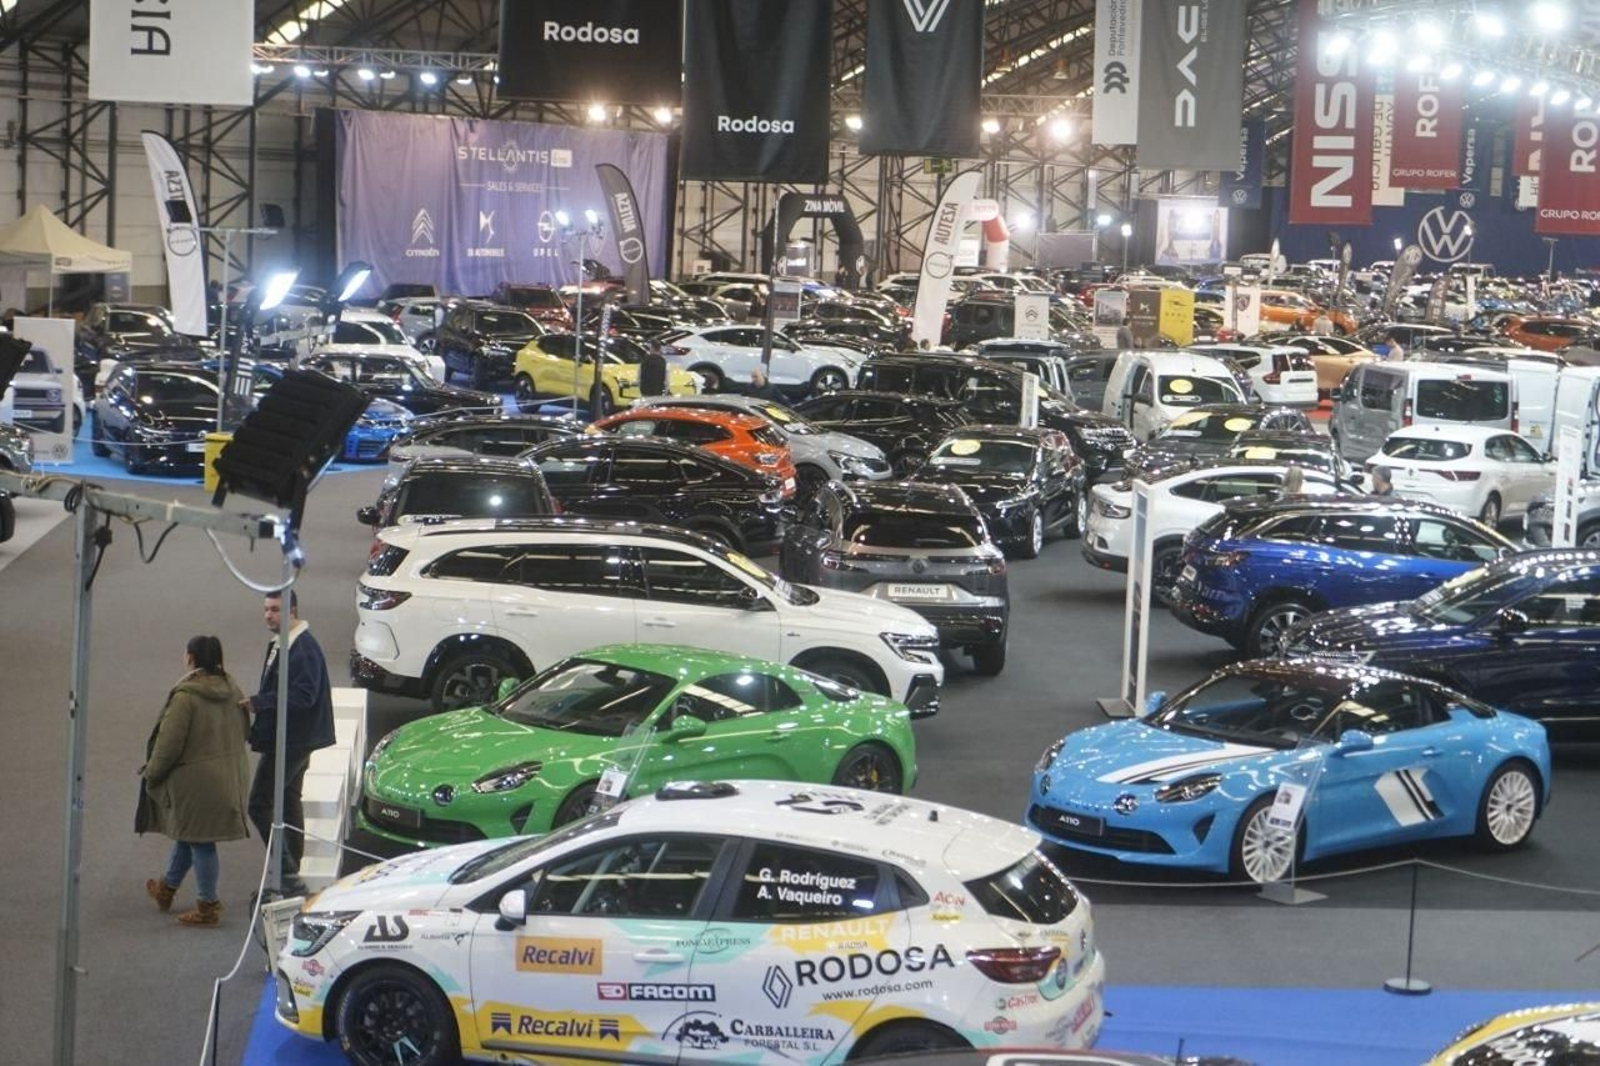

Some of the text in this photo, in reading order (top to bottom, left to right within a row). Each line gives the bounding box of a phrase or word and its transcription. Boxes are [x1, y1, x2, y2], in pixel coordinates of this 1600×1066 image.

[544, 21, 639, 44] Rodosa
[717, 115, 795, 134] Rodosa
[458, 146, 549, 164] STELLANTIS
[1461, 129, 1476, 184] Vepersa
[1392, 168, 1456, 178] GRUPO ROFER
[934, 202, 959, 245] AUTESA
[1541, 209, 1579, 219] GRUPO
[894, 586, 940, 595] RENAULT
[381, 808, 400, 818] A110
[1059, 815, 1080, 826] A110
[760, 867, 856, 890] G. Rodríguez
[757, 885, 843, 906] A. Vaqueiro
[781, 919, 890, 942] RENAULT
[522, 945, 596, 966] Recalvi
[795, 943, 956, 987] RODOSA
[630, 985, 712, 999] FACOM
[822, 978, 934, 1001] www.rodosa.com
[517, 1015, 594, 1038] Recalvi
[729, 1018, 836, 1041] CARBALLEIRA
[744, 1038, 801, 1051] FORESTAL
